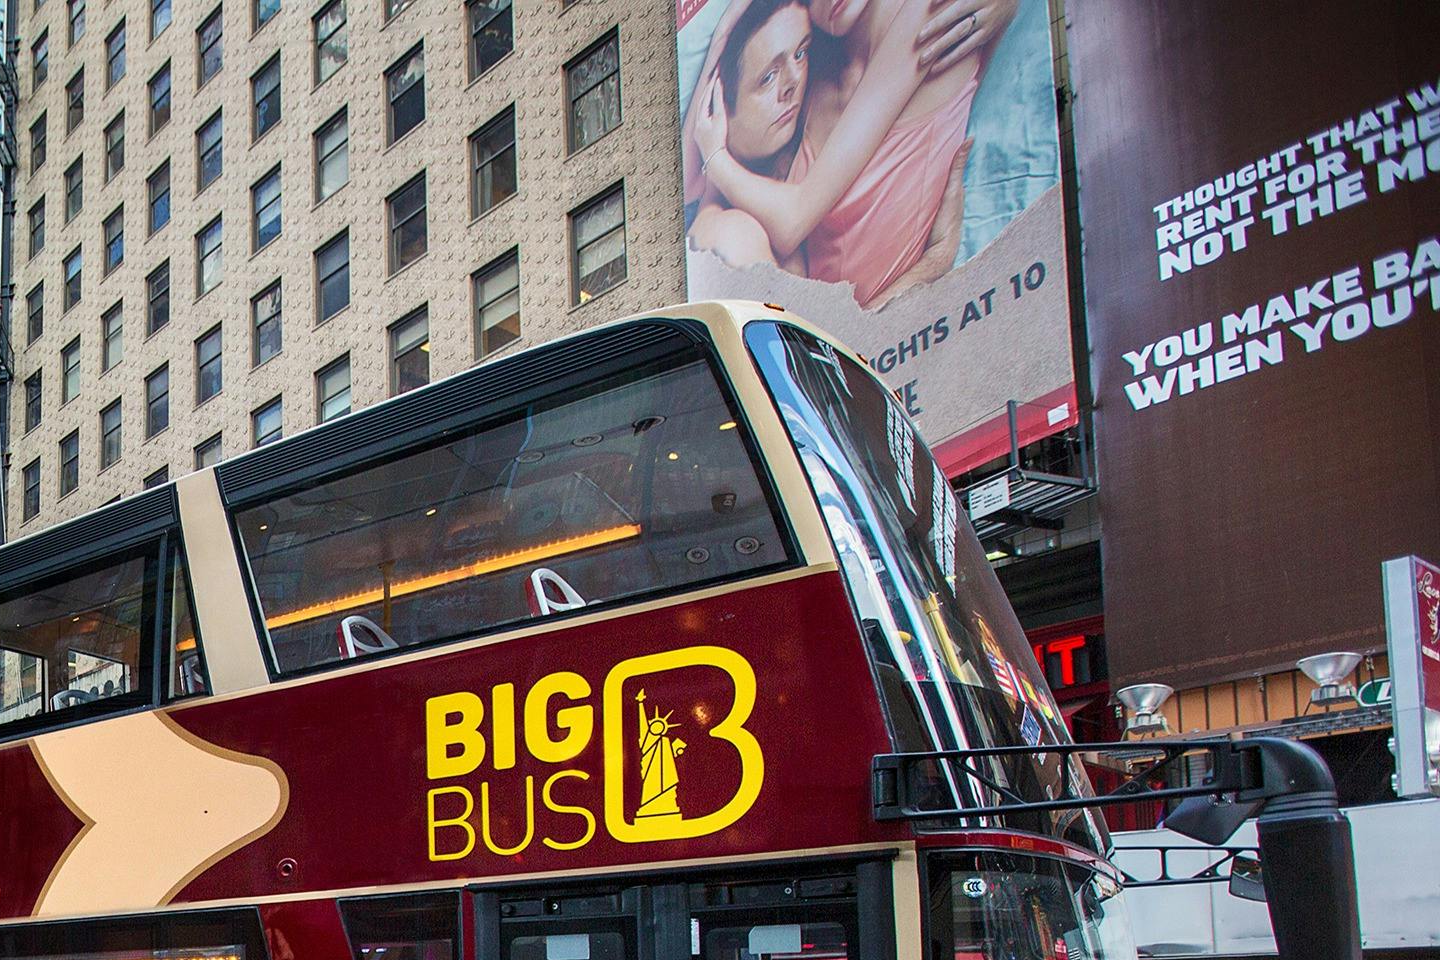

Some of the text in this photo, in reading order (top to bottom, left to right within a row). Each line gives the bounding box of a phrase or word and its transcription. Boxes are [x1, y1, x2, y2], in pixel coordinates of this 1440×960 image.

[1153, 142, 1303, 224] THOUGHT
[1306, 99, 1401, 156] THAT
[1155, 187, 1258, 251] RENT
[1264, 151, 1348, 205] FOR
[1158, 216, 1255, 282] NOT
[1262, 170, 1367, 236] THE
[959, 287, 997, 332] AT
[1009, 261, 1047, 300] 10
[1122, 321, 1213, 377] YOU
[1221, 267, 1363, 344] MAKE
[1123, 330, 1284, 411] WHEN
[426, 671, 594, 780] BIG
[427, 769, 597, 862] BUS
